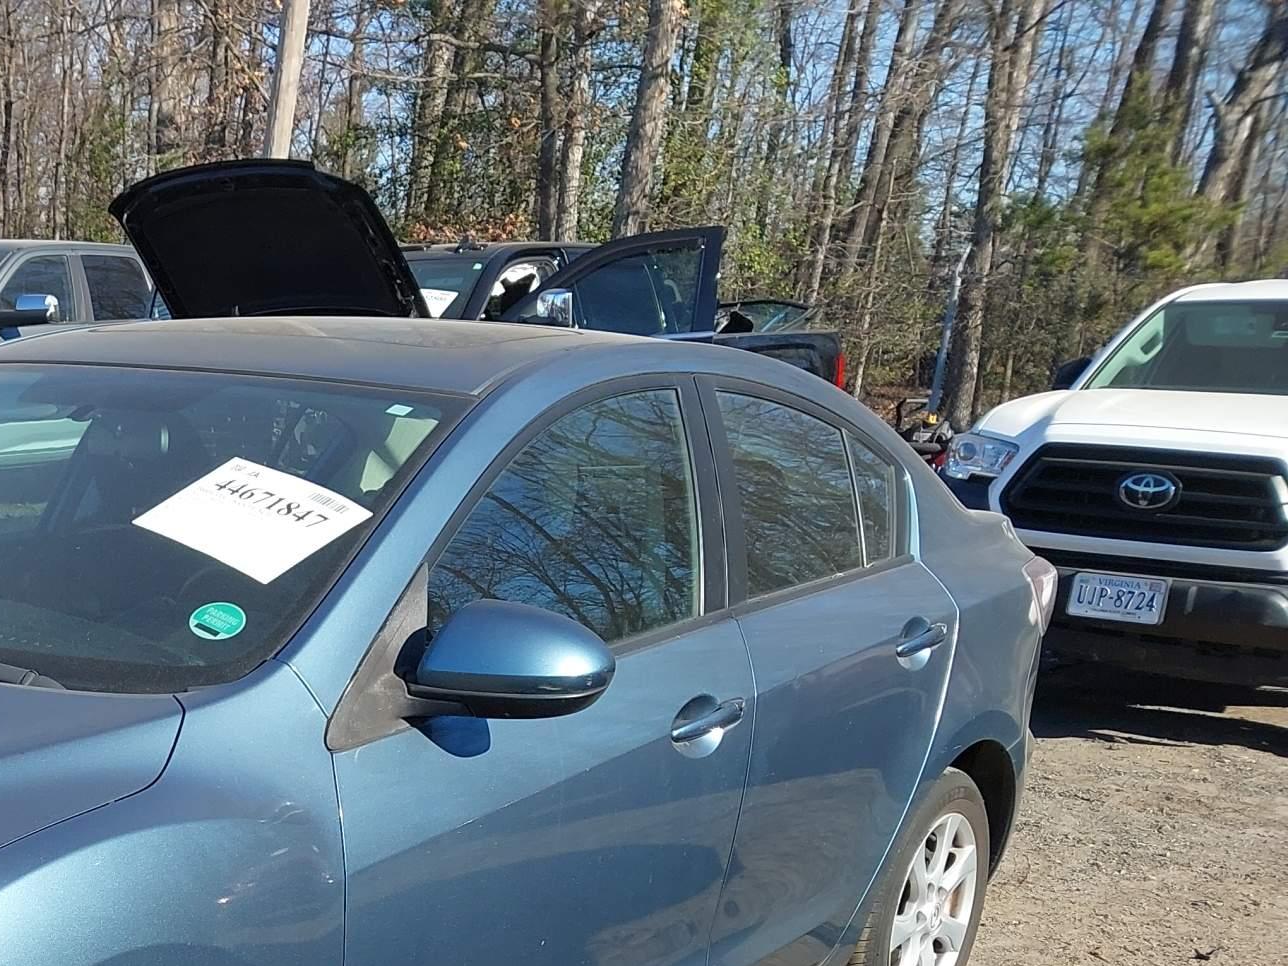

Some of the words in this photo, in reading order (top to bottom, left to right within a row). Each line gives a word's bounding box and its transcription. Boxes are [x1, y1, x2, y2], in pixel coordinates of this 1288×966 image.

[215, 479, 329, 528] 44671847
[1098, 578, 1141, 590] VIRGINIA
[1077, 584, 1157, 612] UJP-8724
[200, 614, 231, 631] PERMIT
[206, 607, 241, 626] PARKING
